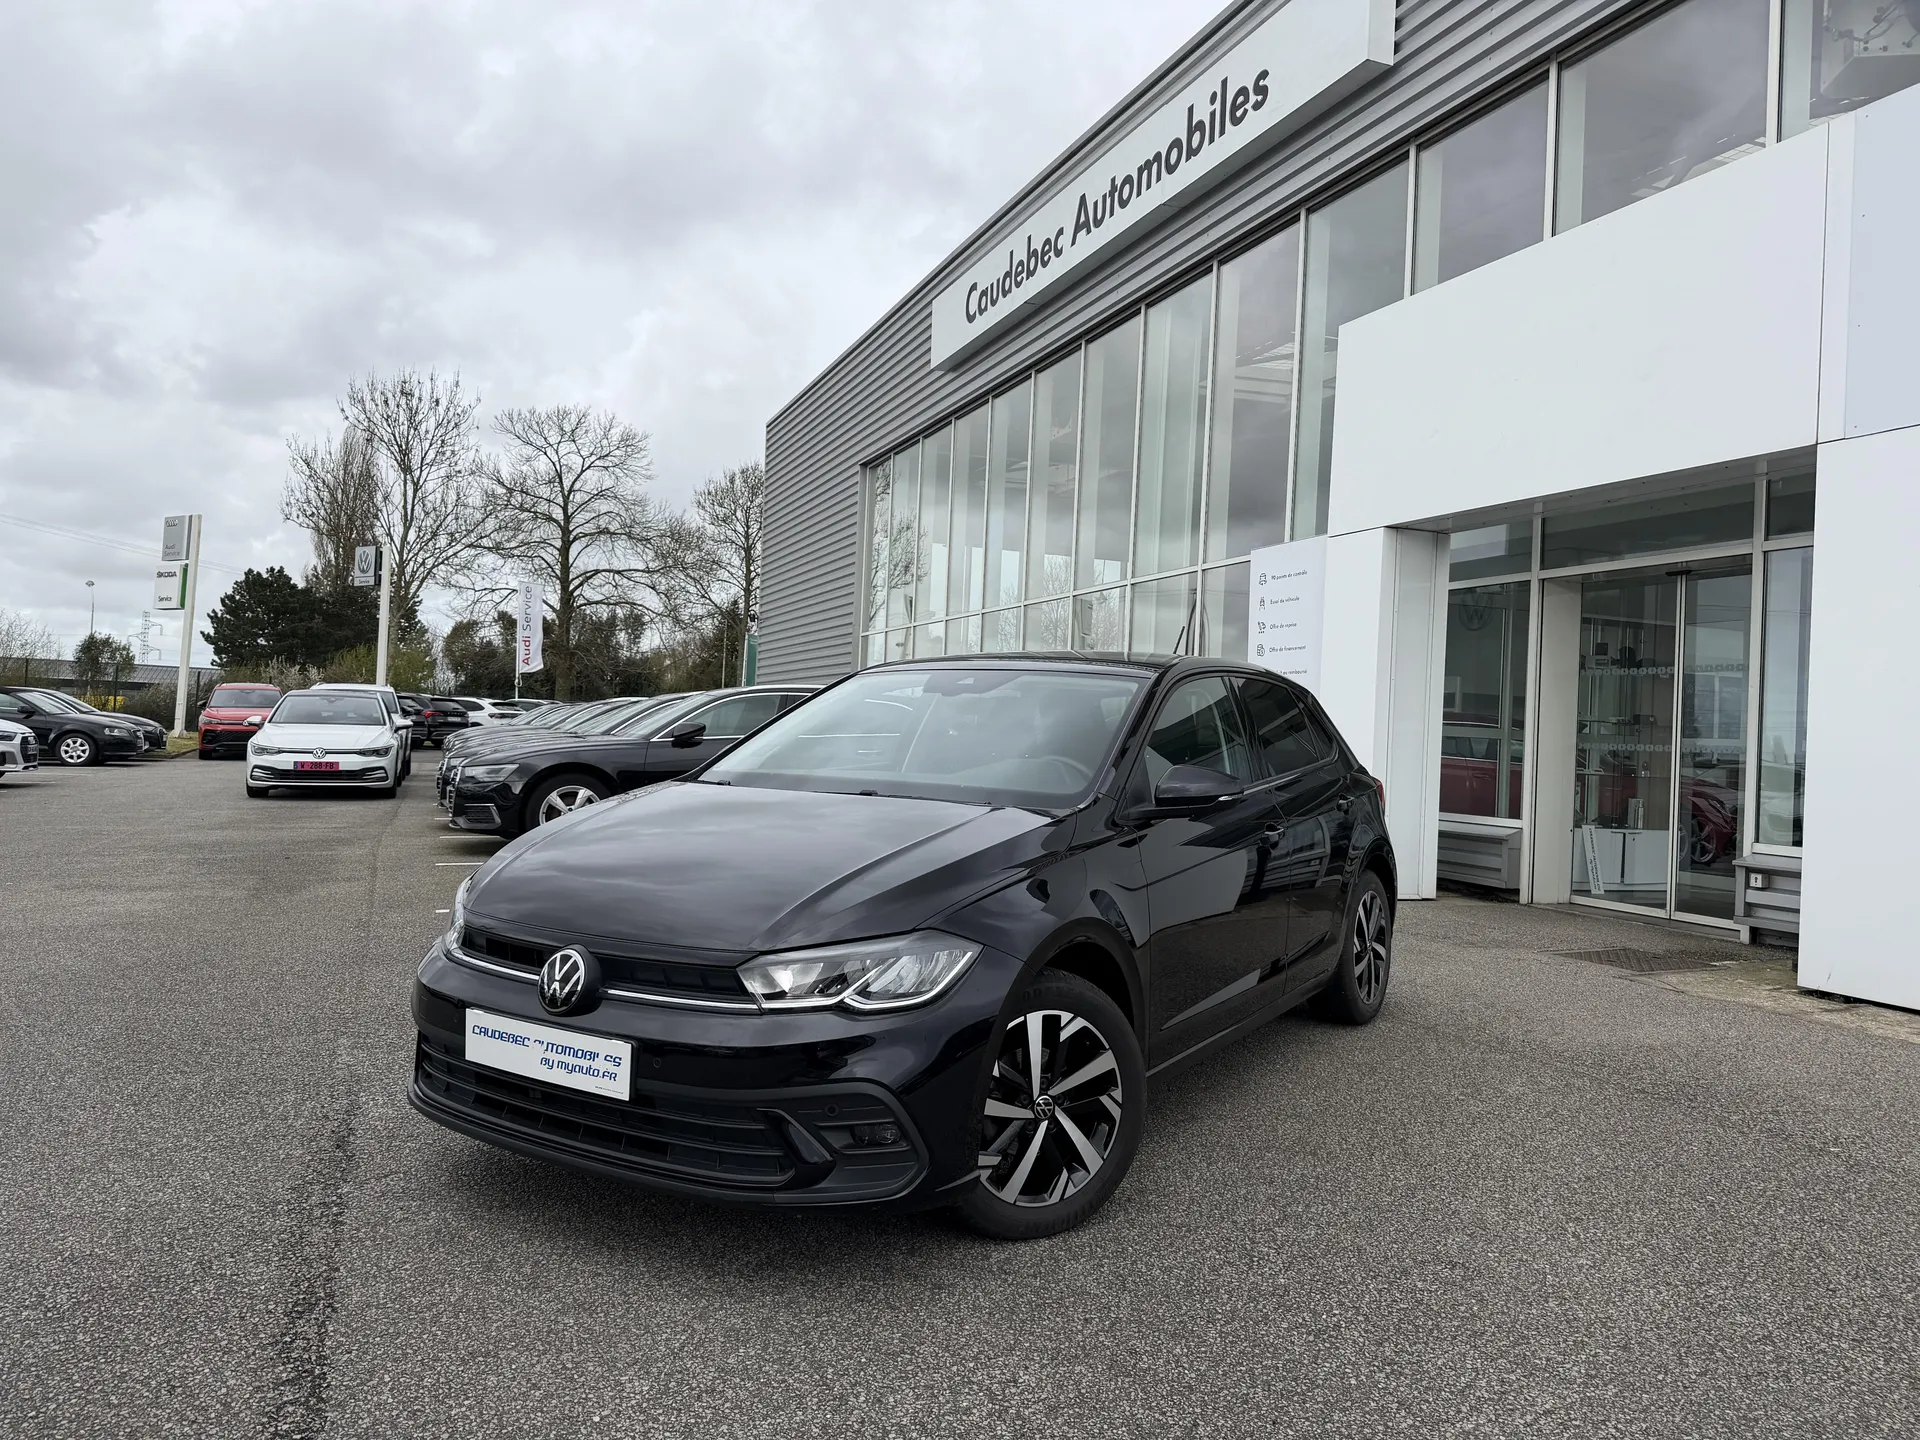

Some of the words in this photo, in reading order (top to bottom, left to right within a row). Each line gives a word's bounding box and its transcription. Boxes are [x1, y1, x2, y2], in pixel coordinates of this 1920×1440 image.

[965, 226, 1064, 324] Caudebec
[1070, 69, 1269, 248] Automobiles
[522, 586, 532, 631] Service
[522, 635, 531, 666] Audi
[472, 1025, 530, 1047] CAUDEBEC
